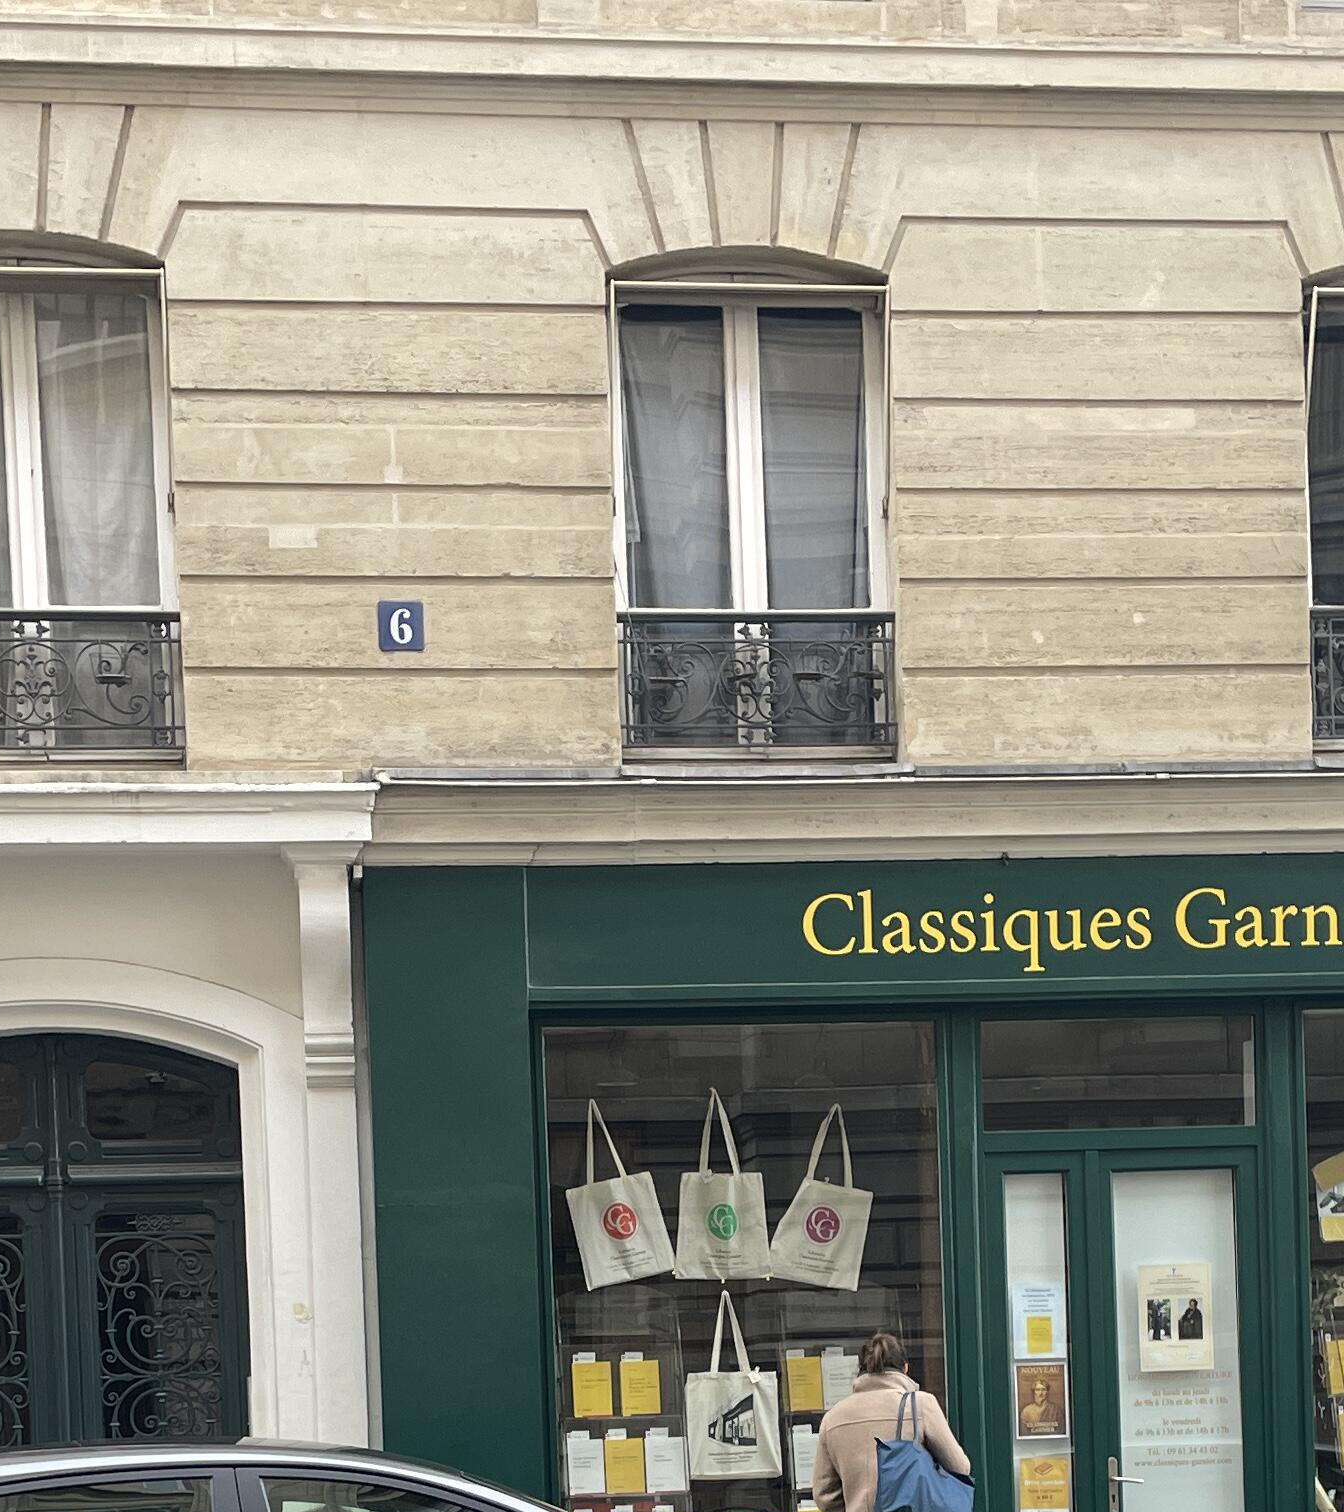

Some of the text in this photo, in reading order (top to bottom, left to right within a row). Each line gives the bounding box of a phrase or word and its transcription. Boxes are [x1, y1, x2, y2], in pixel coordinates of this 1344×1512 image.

[389, 608, 413, 644] 6
[801, 889, 1152, 973] Classiques
[1021, 1366, 1060, 1374] NOUVEAU
